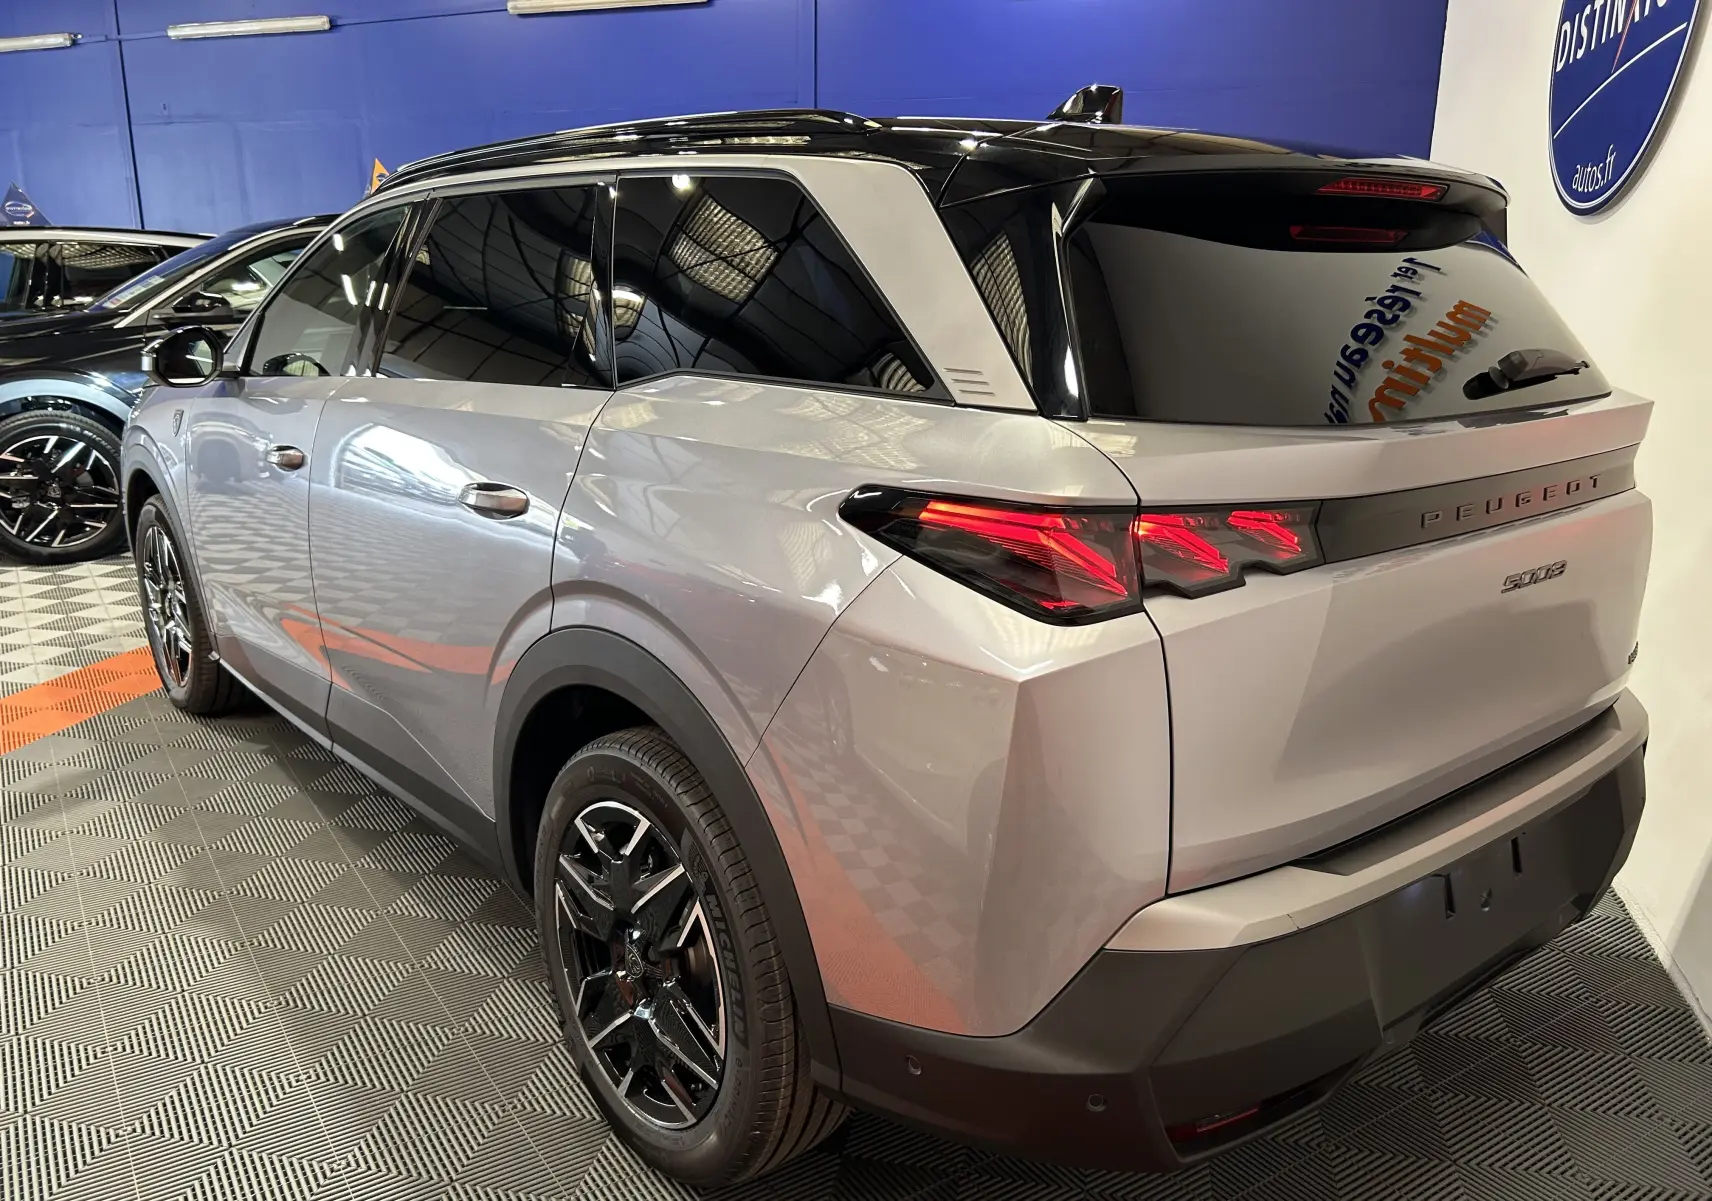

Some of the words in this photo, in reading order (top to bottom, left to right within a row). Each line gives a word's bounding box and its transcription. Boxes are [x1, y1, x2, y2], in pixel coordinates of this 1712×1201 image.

[1556, 0, 1667, 72] DISTIN
[1572, 144, 1616, 192] autos.fr
[1421, 474, 1601, 529] PEUGEOT
[1501, 560, 1567, 593] 5008
[706, 894, 746, 1041] MICHELIN
